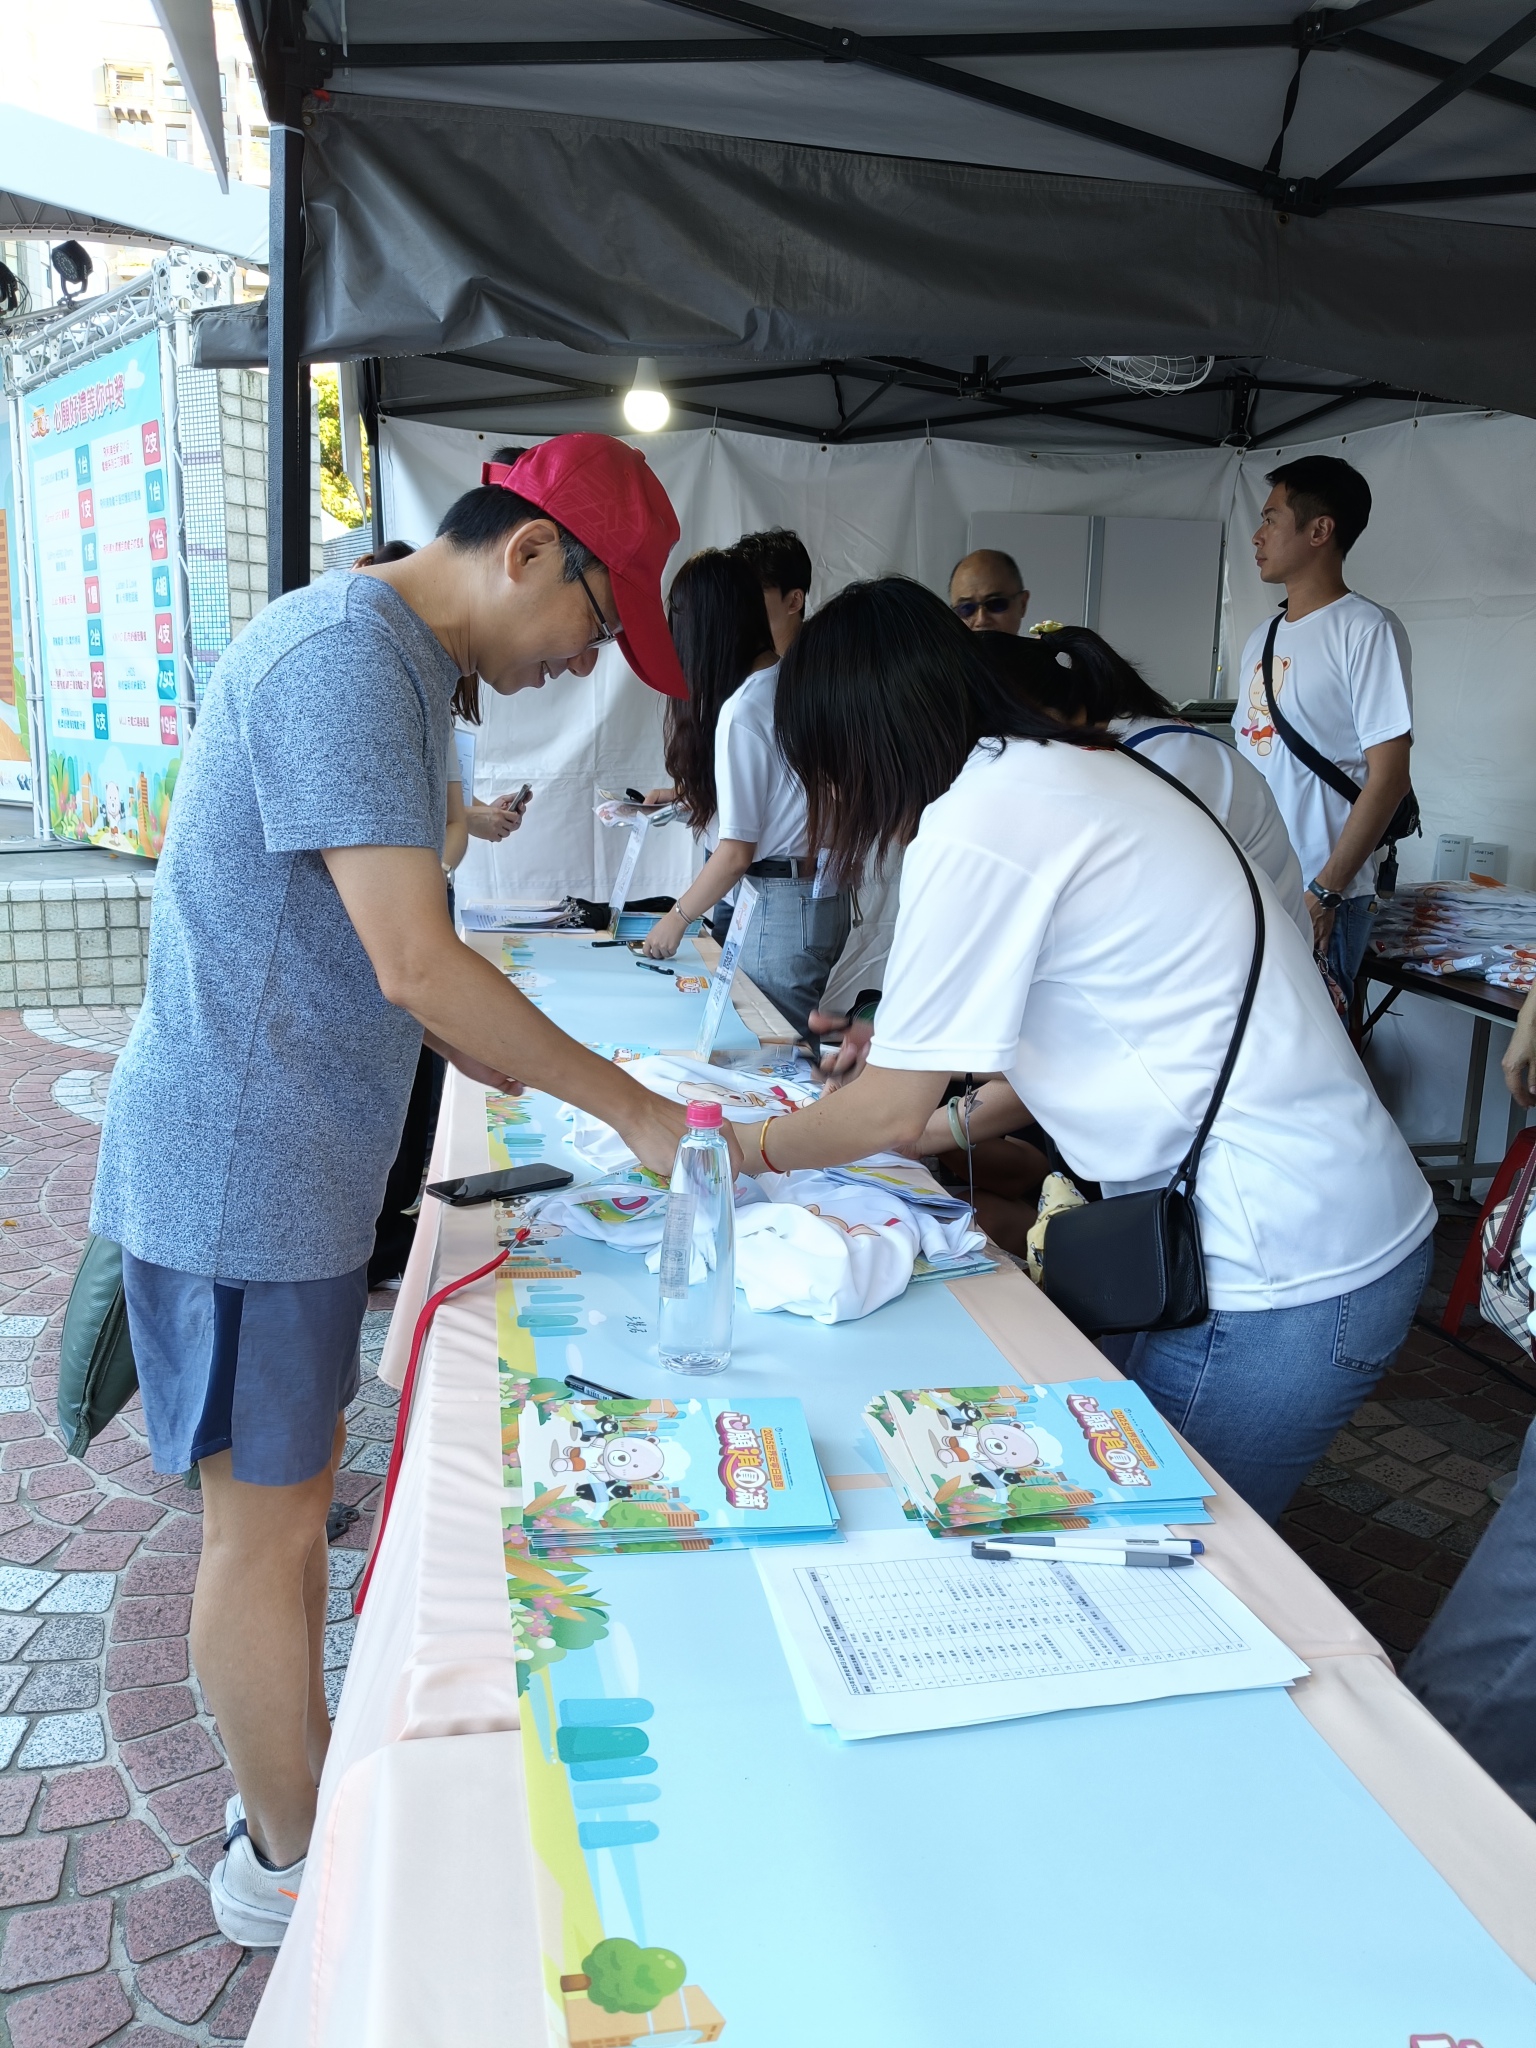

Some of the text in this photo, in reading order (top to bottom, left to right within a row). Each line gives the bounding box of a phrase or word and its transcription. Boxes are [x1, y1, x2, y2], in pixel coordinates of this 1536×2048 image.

[53, 374, 125, 434] 心願好禮等你中獎
[144, 431, 158, 454] 2支
[78, 455, 88, 475] 1台
[149, 480, 160, 501] 1台
[81, 499, 91, 518] 1支
[152, 529, 164, 549] 1台
[90, 628, 101, 646] 2台
[158, 623, 170, 644] 4支
[93, 670, 104, 689] 2支
[161, 717, 177, 735] 19台
[1067, 1394, 1151, 1486] 心願追圓滿
[716, 1411, 768, 1509] 心願追圓滿
[763, 1429, 784, 1488] 2025世界安寧日路跑
